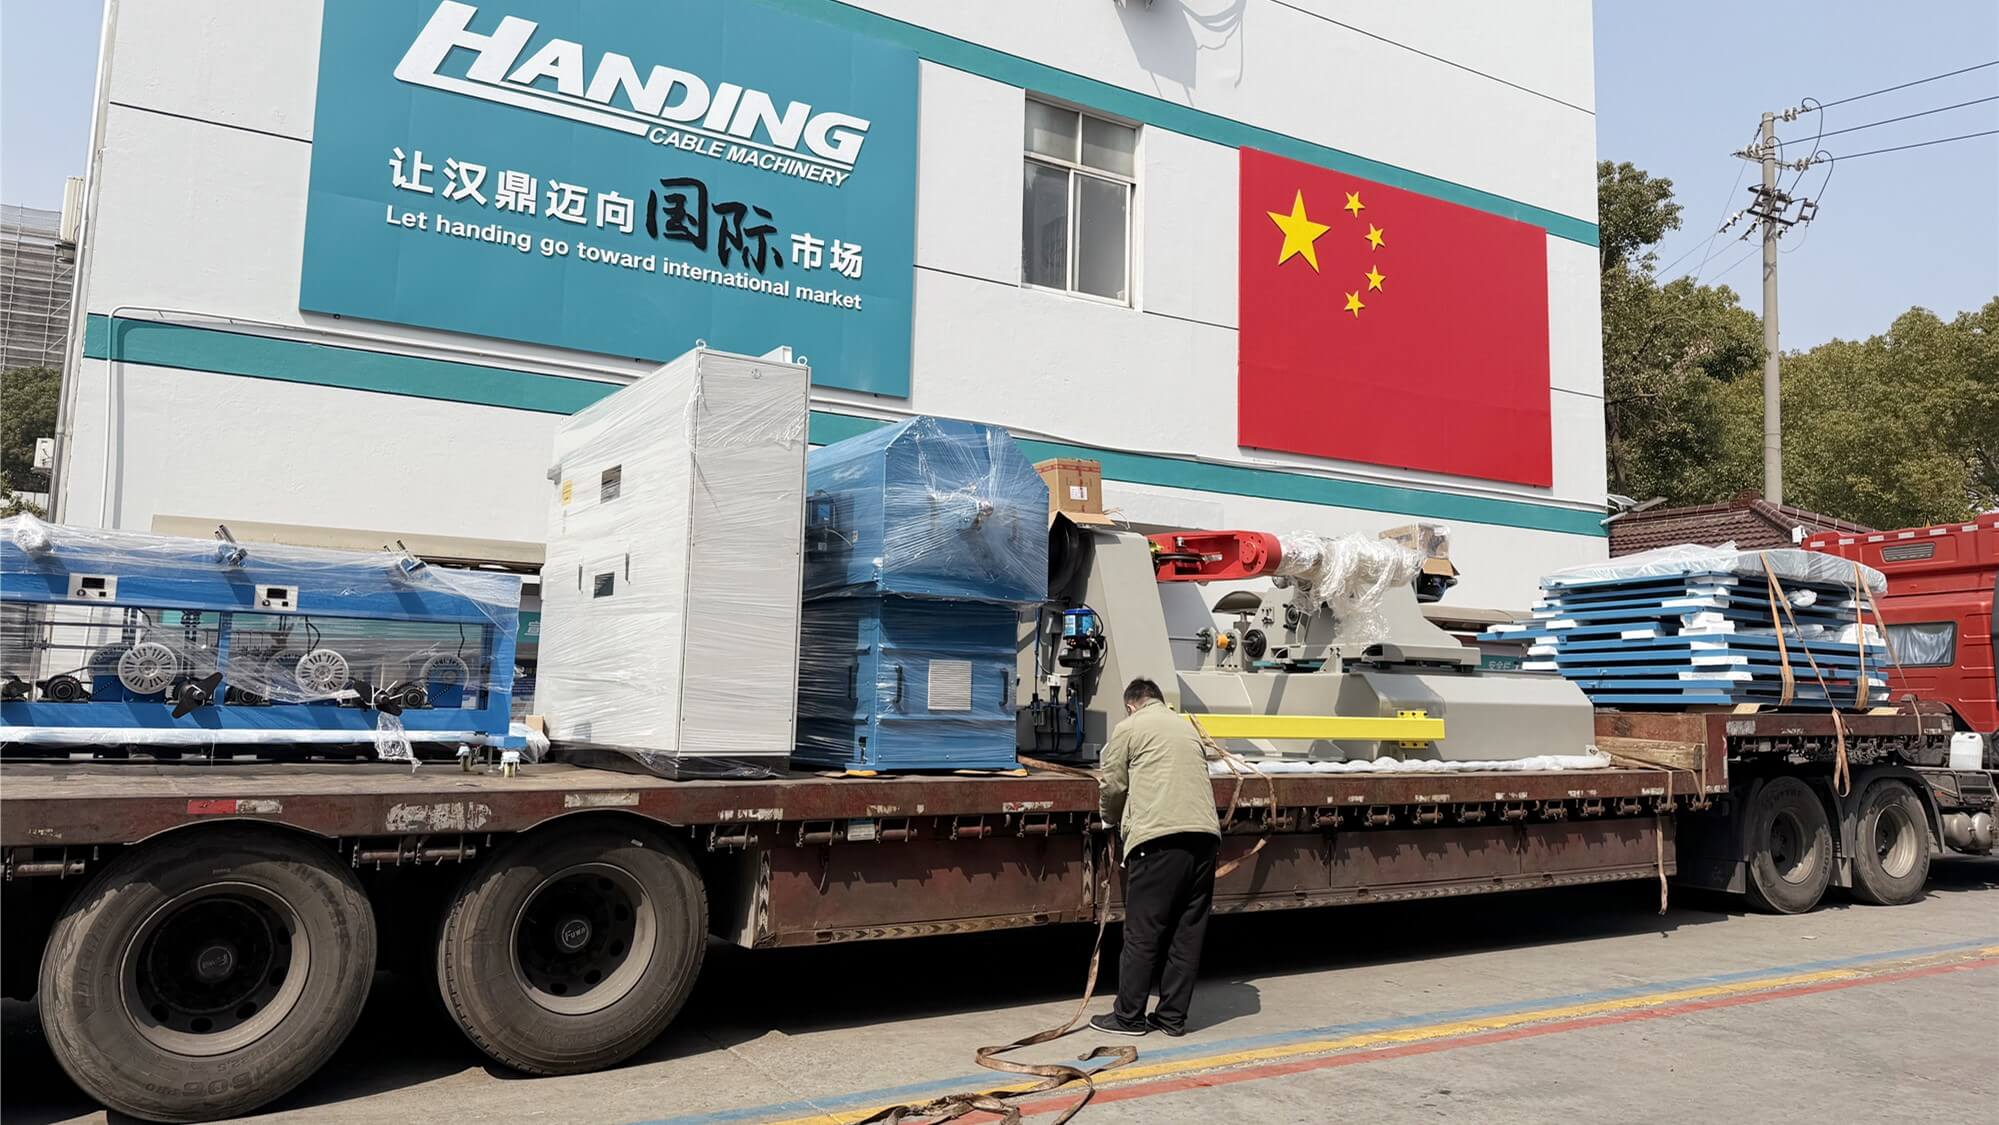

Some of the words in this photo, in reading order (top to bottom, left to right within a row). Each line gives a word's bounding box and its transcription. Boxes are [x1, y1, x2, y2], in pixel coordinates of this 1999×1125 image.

[393, 0, 870, 165] HANDING
[649, 127, 726, 158] CABLE
[726, 146, 850, 187] MACHINERY
[386, 205, 427, 229] Let
[436, 214, 532, 252] handing
[540, 238, 569, 256] go
[577, 241, 656, 272] toward
[663, 257, 789, 297] international
[796, 285, 862, 310] market
